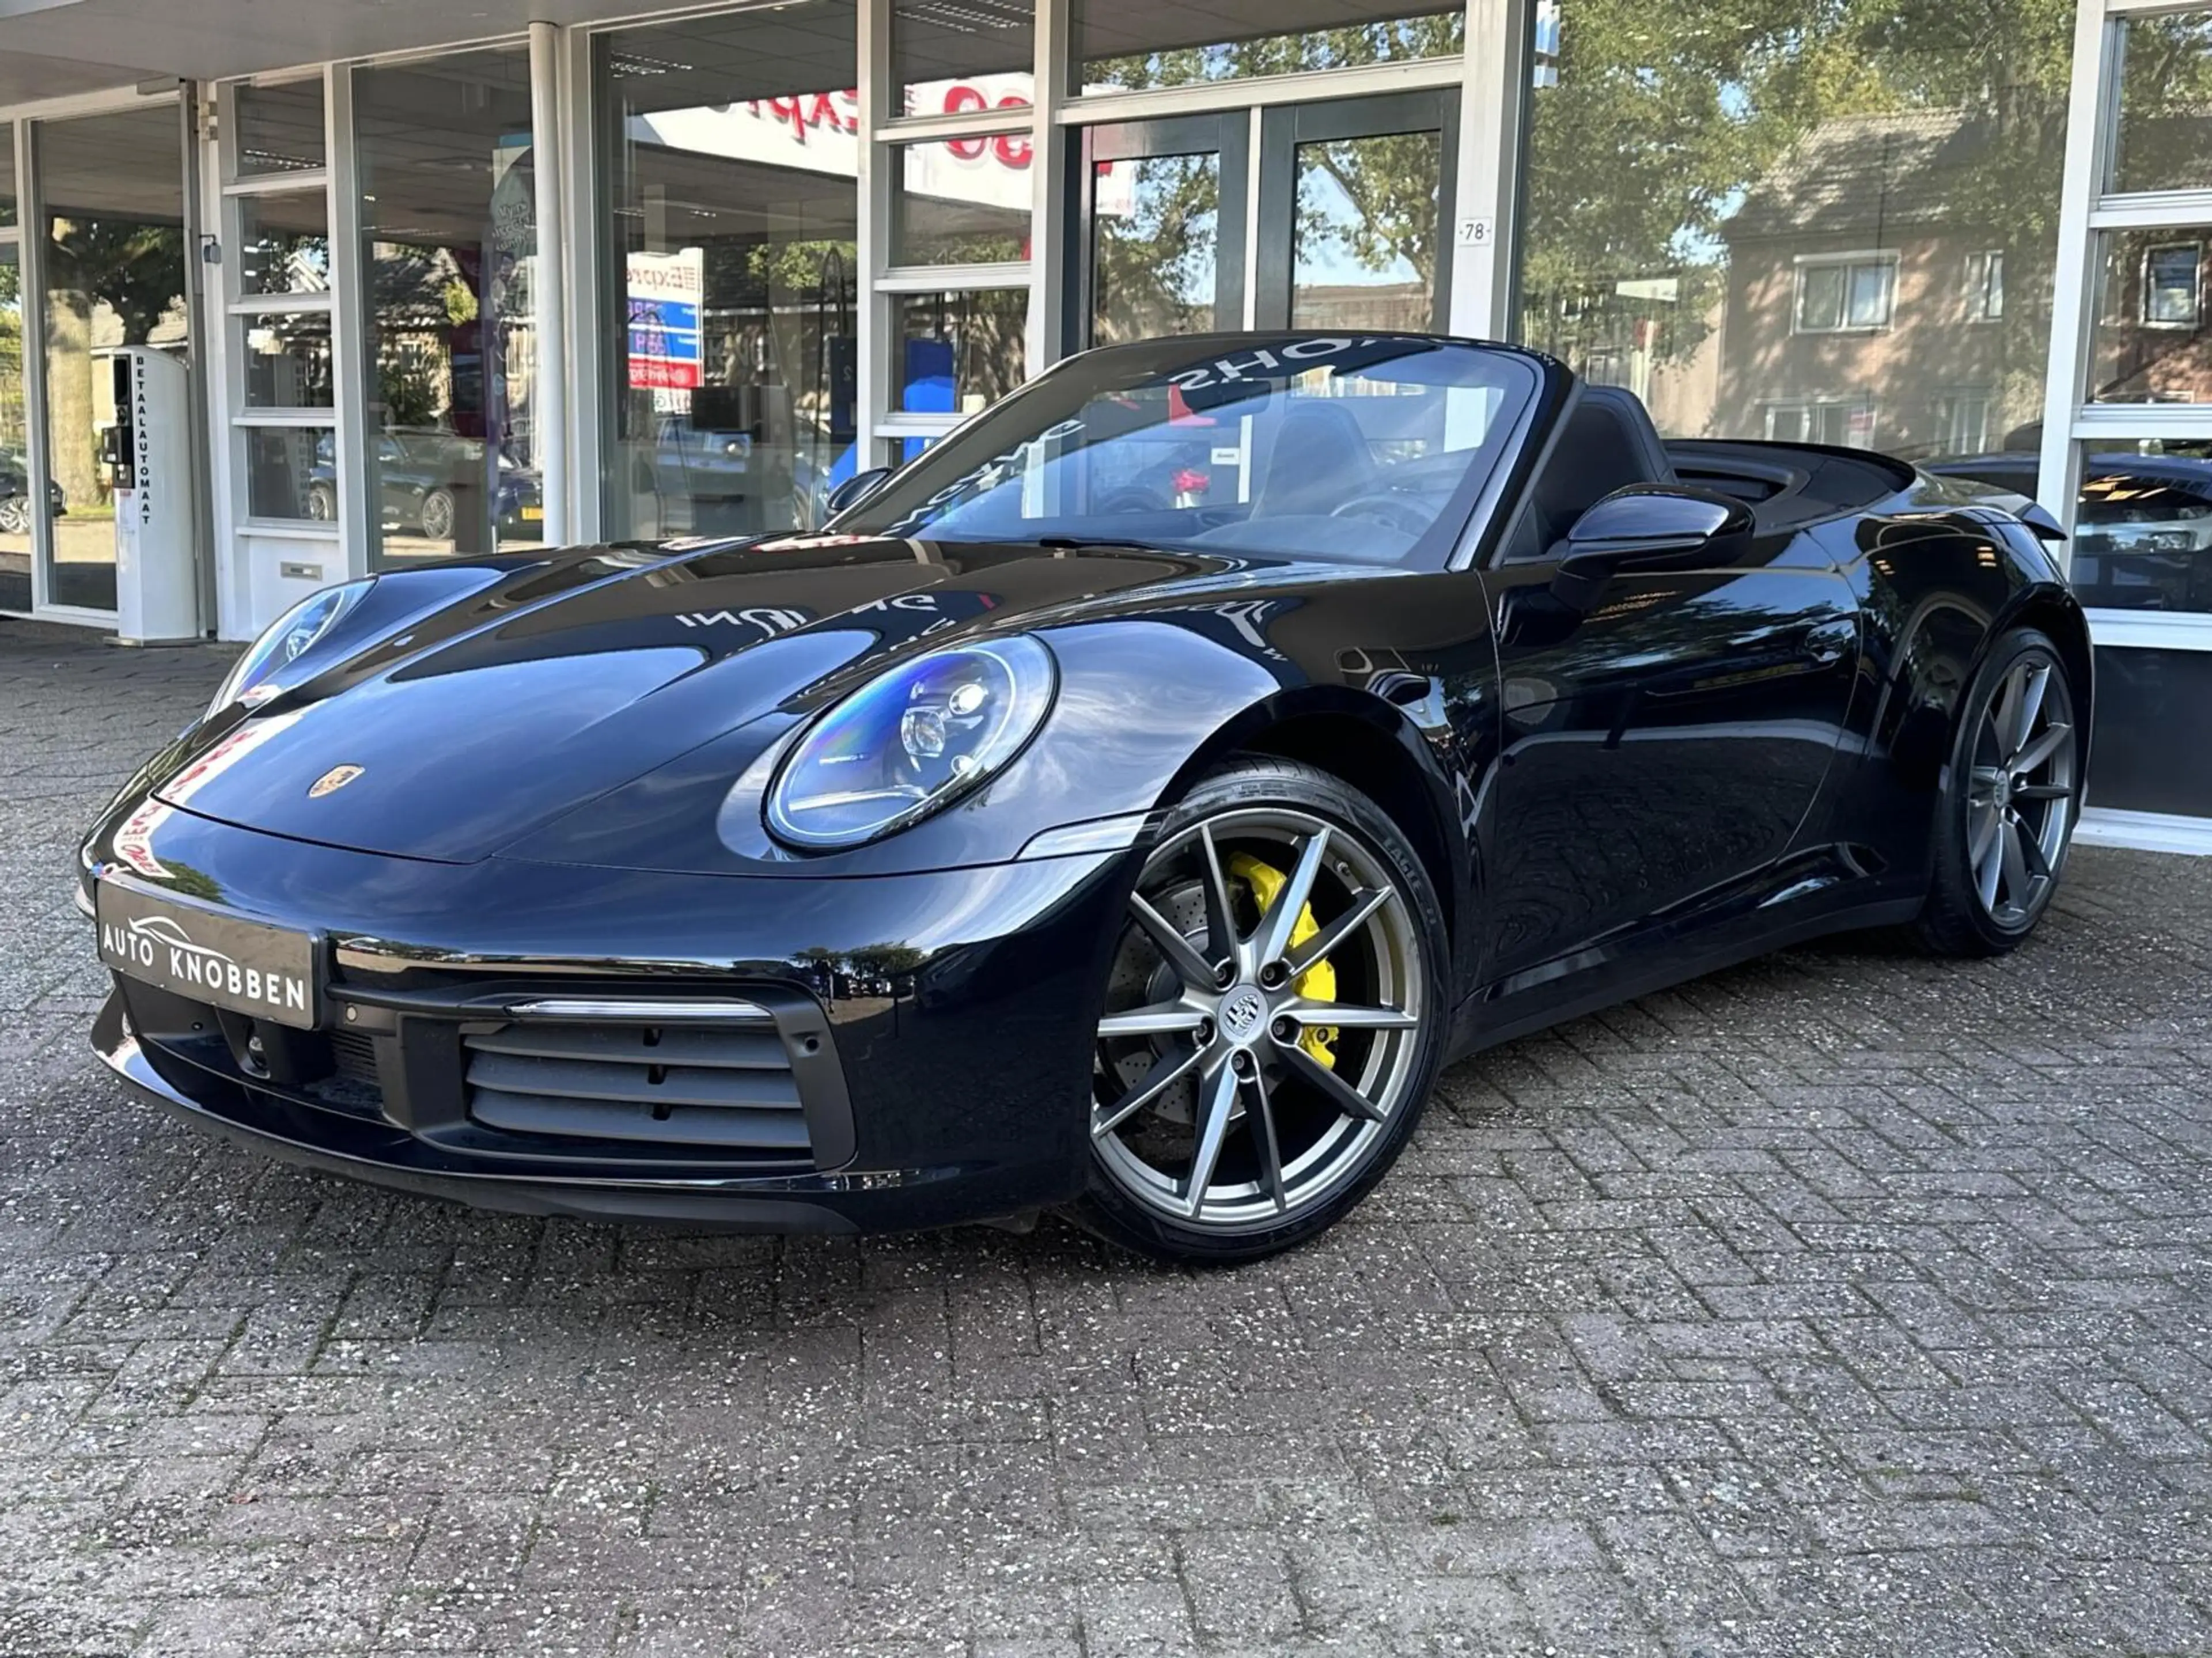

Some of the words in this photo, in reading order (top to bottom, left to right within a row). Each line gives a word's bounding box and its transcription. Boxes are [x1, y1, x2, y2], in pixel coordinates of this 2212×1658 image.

[1466, 223, 1484, 240] 78
[136, 356, 150, 525] BETAALAUTOMAAT
[104, 923, 154, 967] AUTO
[171, 947, 305, 1011] KNOBBEN
